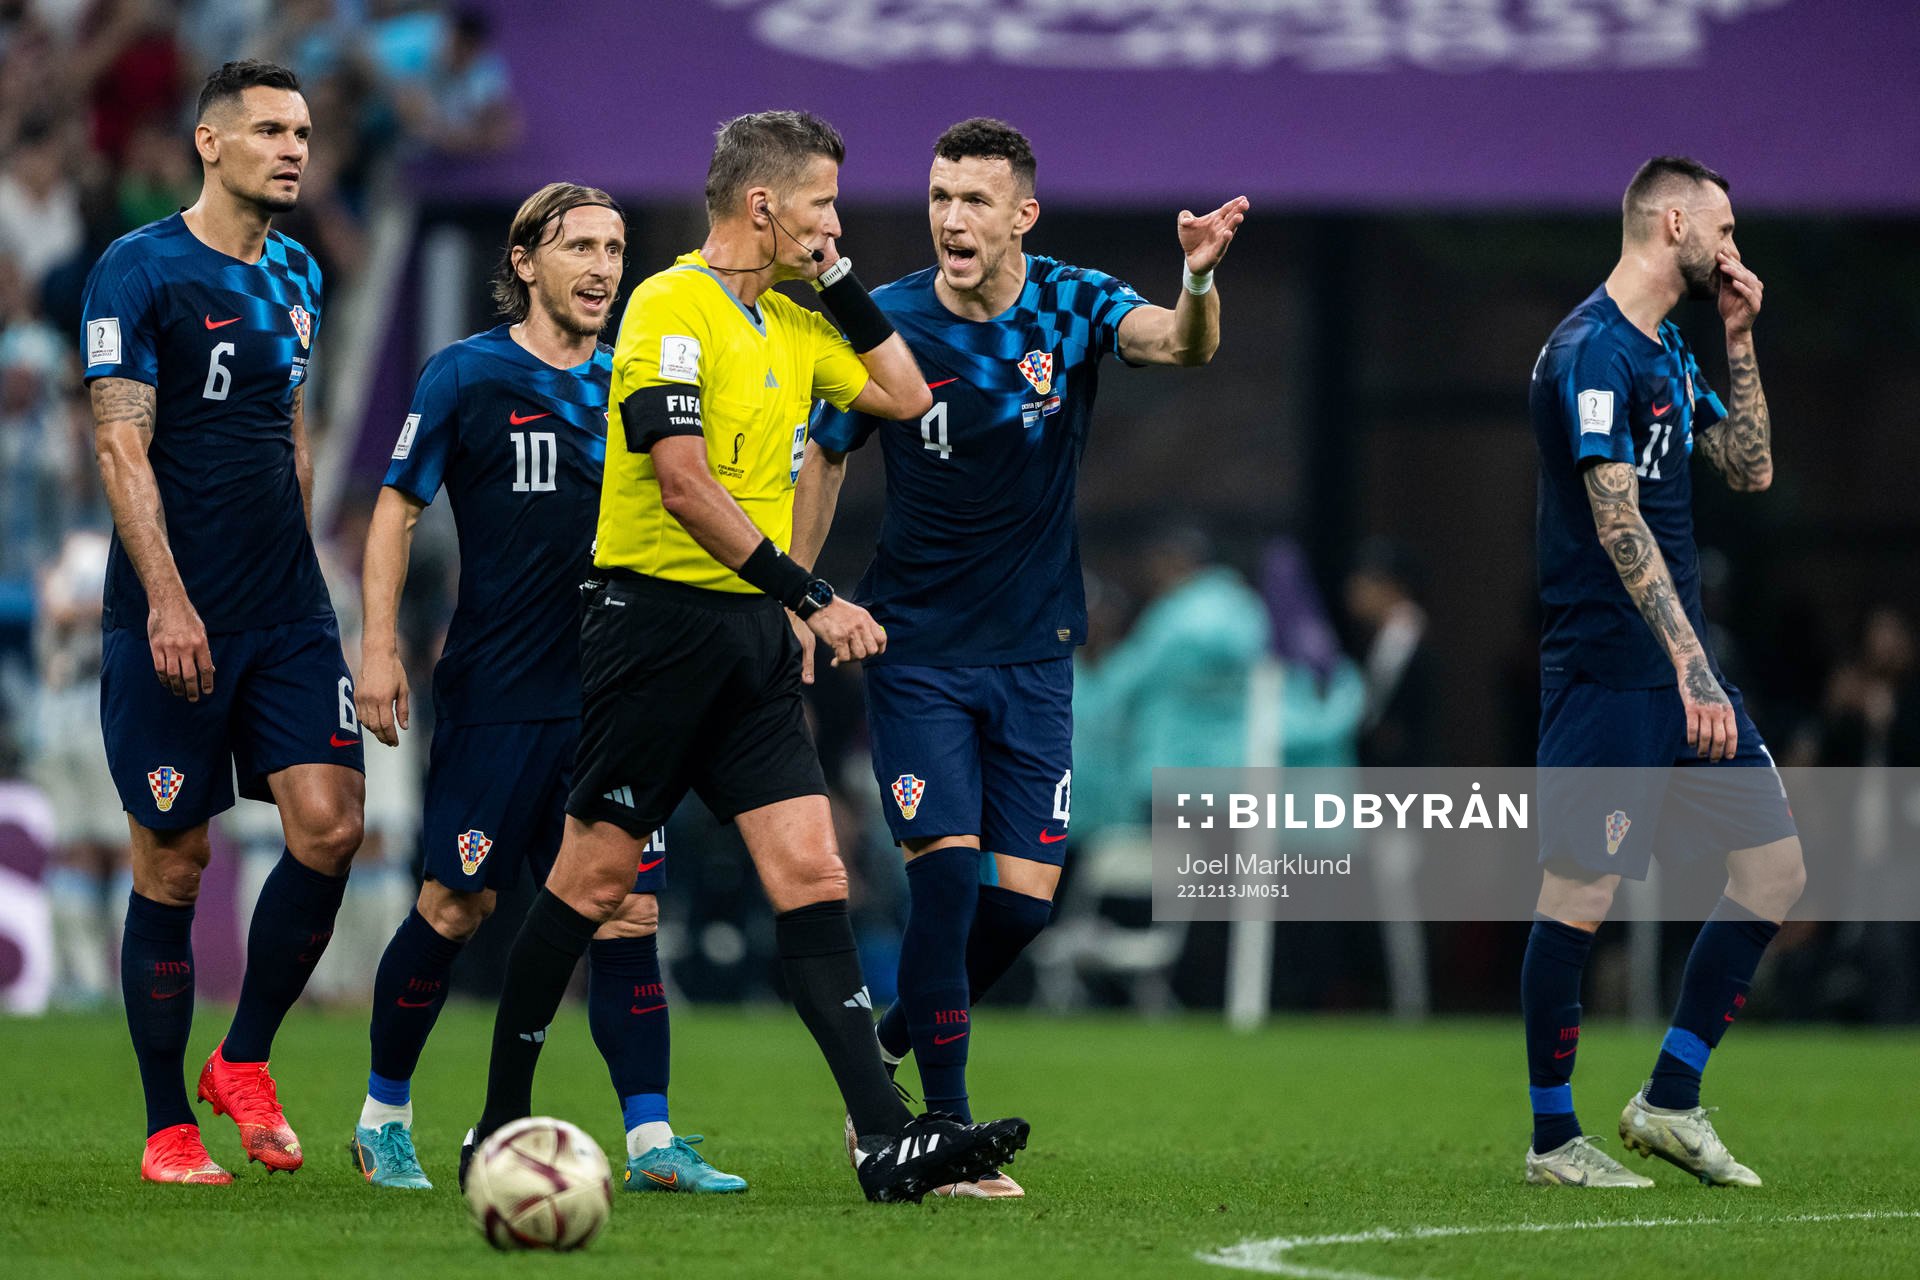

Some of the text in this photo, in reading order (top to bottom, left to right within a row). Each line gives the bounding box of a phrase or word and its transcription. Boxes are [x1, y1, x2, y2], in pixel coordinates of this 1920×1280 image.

[203, 341, 235, 400] 6
[669, 416, 694, 426] TEAM
[920, 401, 953, 460] 4
[510, 431, 557, 491] 10
[1636, 423, 1673, 479] 11
[338, 676, 358, 735] 6
[1053, 769, 1072, 828] 4
